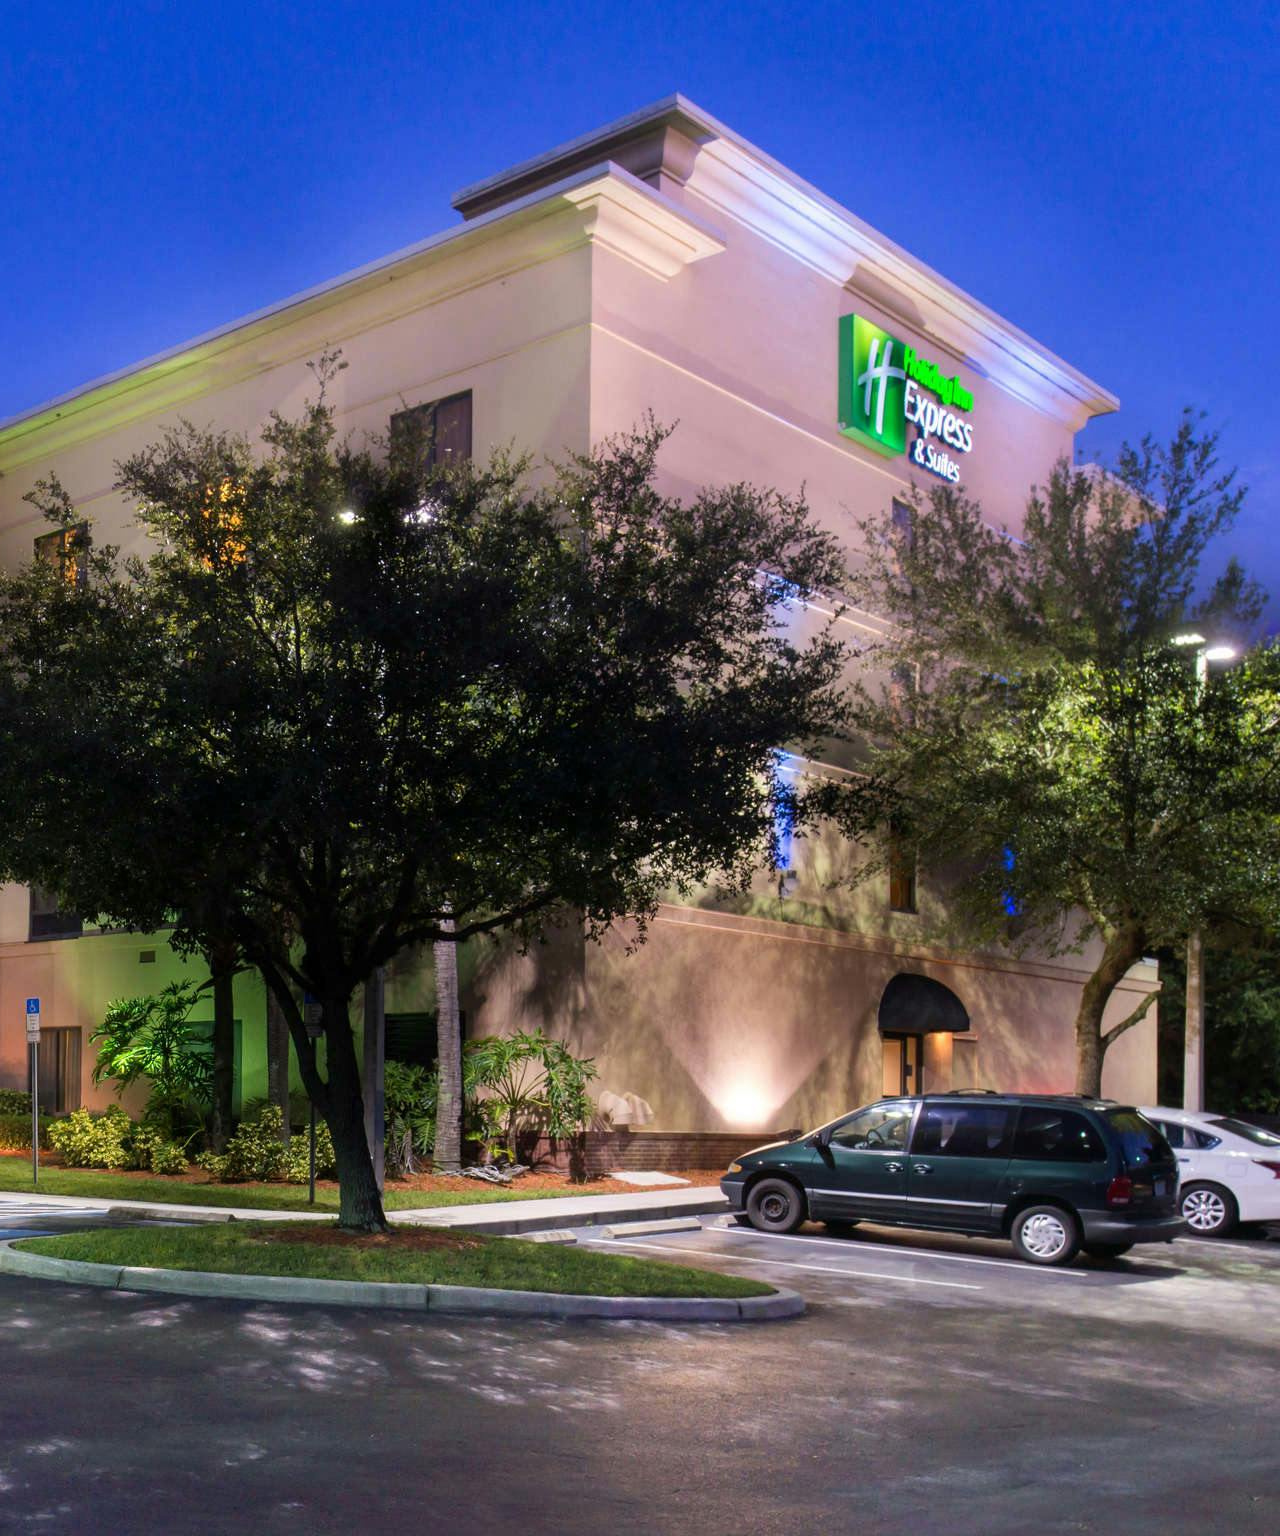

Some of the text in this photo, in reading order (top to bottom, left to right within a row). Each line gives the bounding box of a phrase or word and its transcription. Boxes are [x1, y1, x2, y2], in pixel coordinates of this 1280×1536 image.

[904, 379, 973, 452] Express
[914, 438, 960, 482] & Suites
